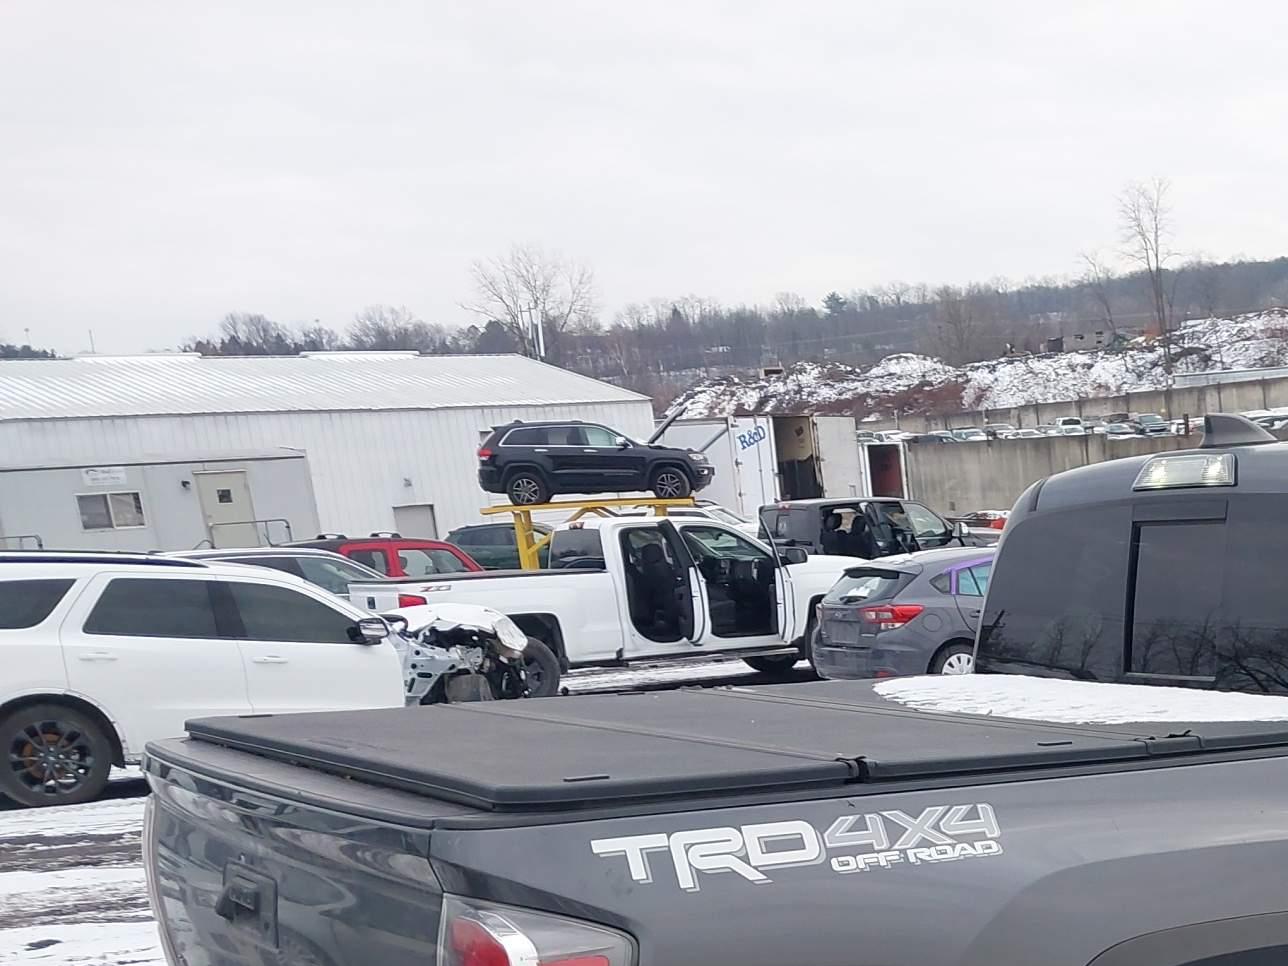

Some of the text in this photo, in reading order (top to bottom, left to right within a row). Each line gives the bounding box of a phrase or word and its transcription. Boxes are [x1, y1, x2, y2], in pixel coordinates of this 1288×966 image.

[737, 425, 766, 450] R&D
[590, 820, 826, 893] TRD
[830, 839, 1004, 875] OFF ROAD
